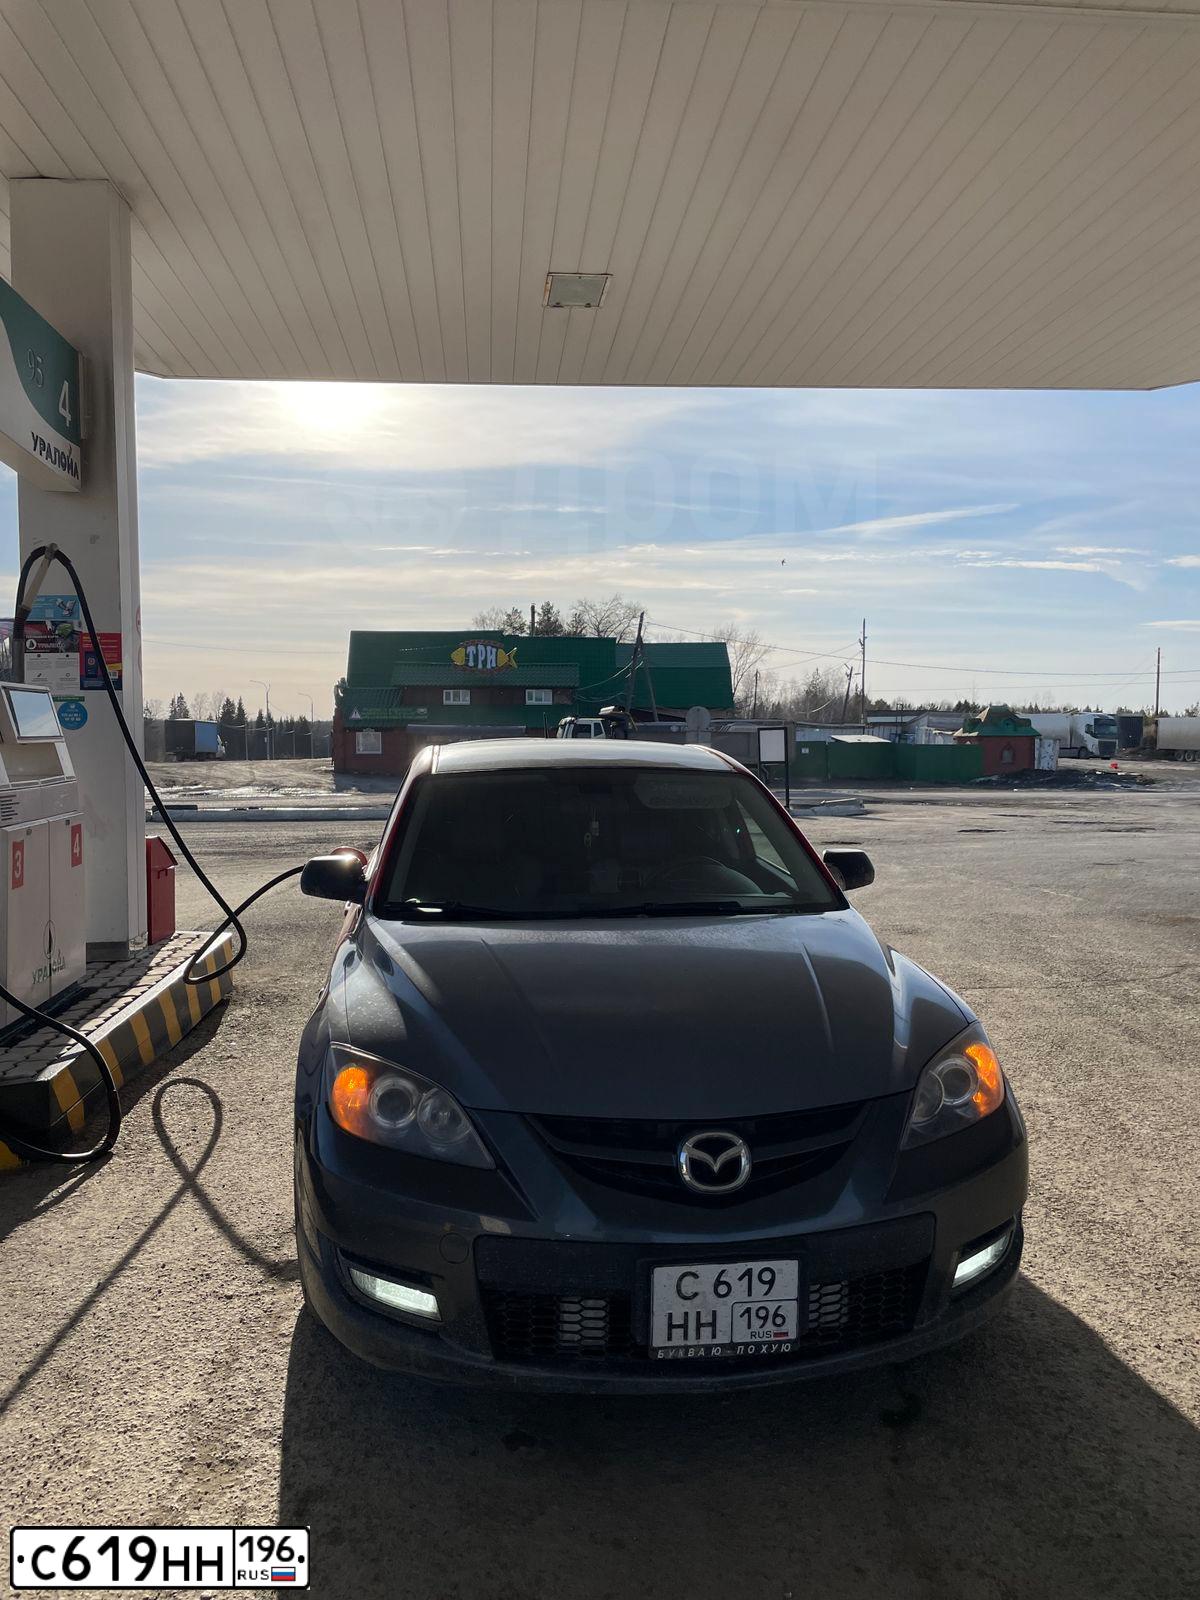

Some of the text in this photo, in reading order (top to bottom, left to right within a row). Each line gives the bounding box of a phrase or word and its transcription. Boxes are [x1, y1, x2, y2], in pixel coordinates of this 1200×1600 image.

[27, 348, 45, 388] 95
[58, 380, 71, 427] 4
[31, 431, 80, 480] УРАЛОЙЛ
[73, 833, 80, 857] 4
[14, 850, 22, 878] 3
[676, 1266, 776, 1300] С 619
[667, 1309, 717, 1342] НН
[739, 1305, 786, 1330] 196
[750, 1330, 772, 1340] RUS
